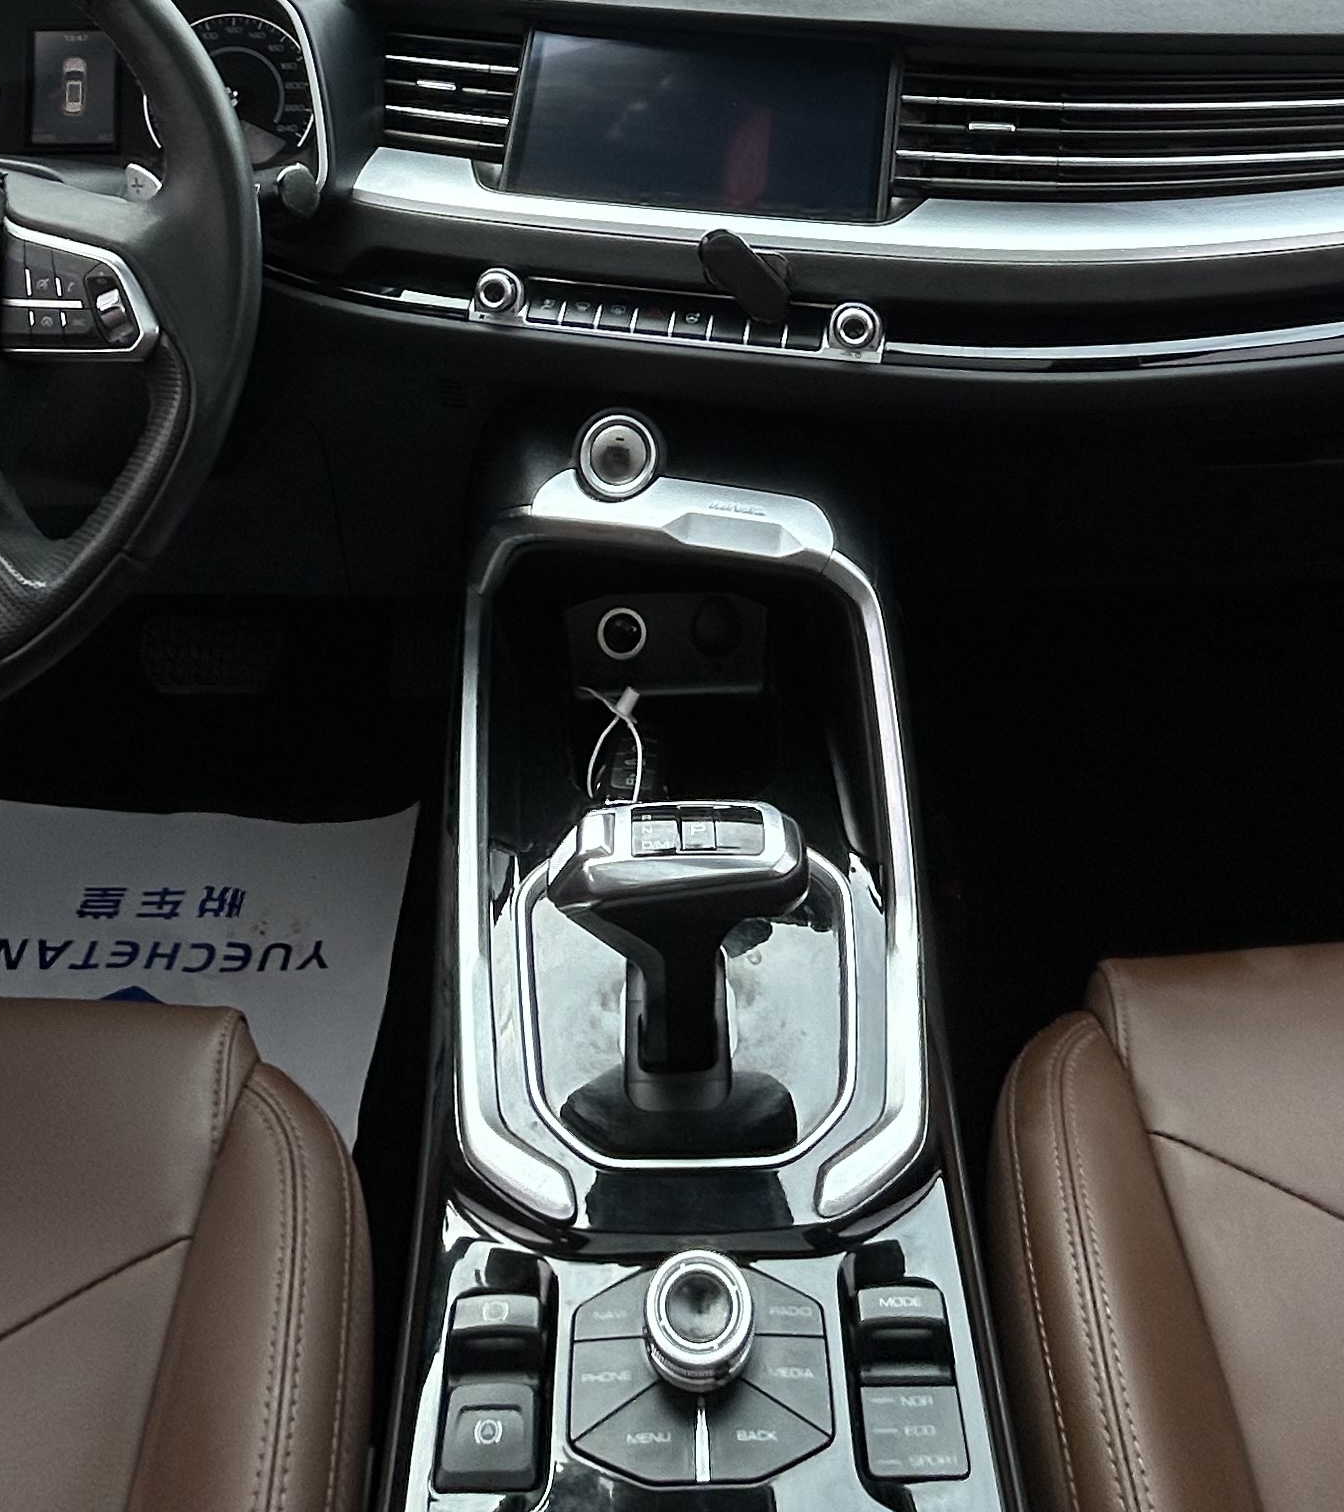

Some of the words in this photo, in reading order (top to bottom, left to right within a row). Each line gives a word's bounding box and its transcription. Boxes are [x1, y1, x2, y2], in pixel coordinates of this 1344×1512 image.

[77, 884, 246, 920] 悦车堂
[879, 1296, 923, 1308] MODE
[581, 1369, 632, 1383] PHONE
[626, 1431, 672, 1444] MENU
[736, 1429, 778, 1442] BACK
